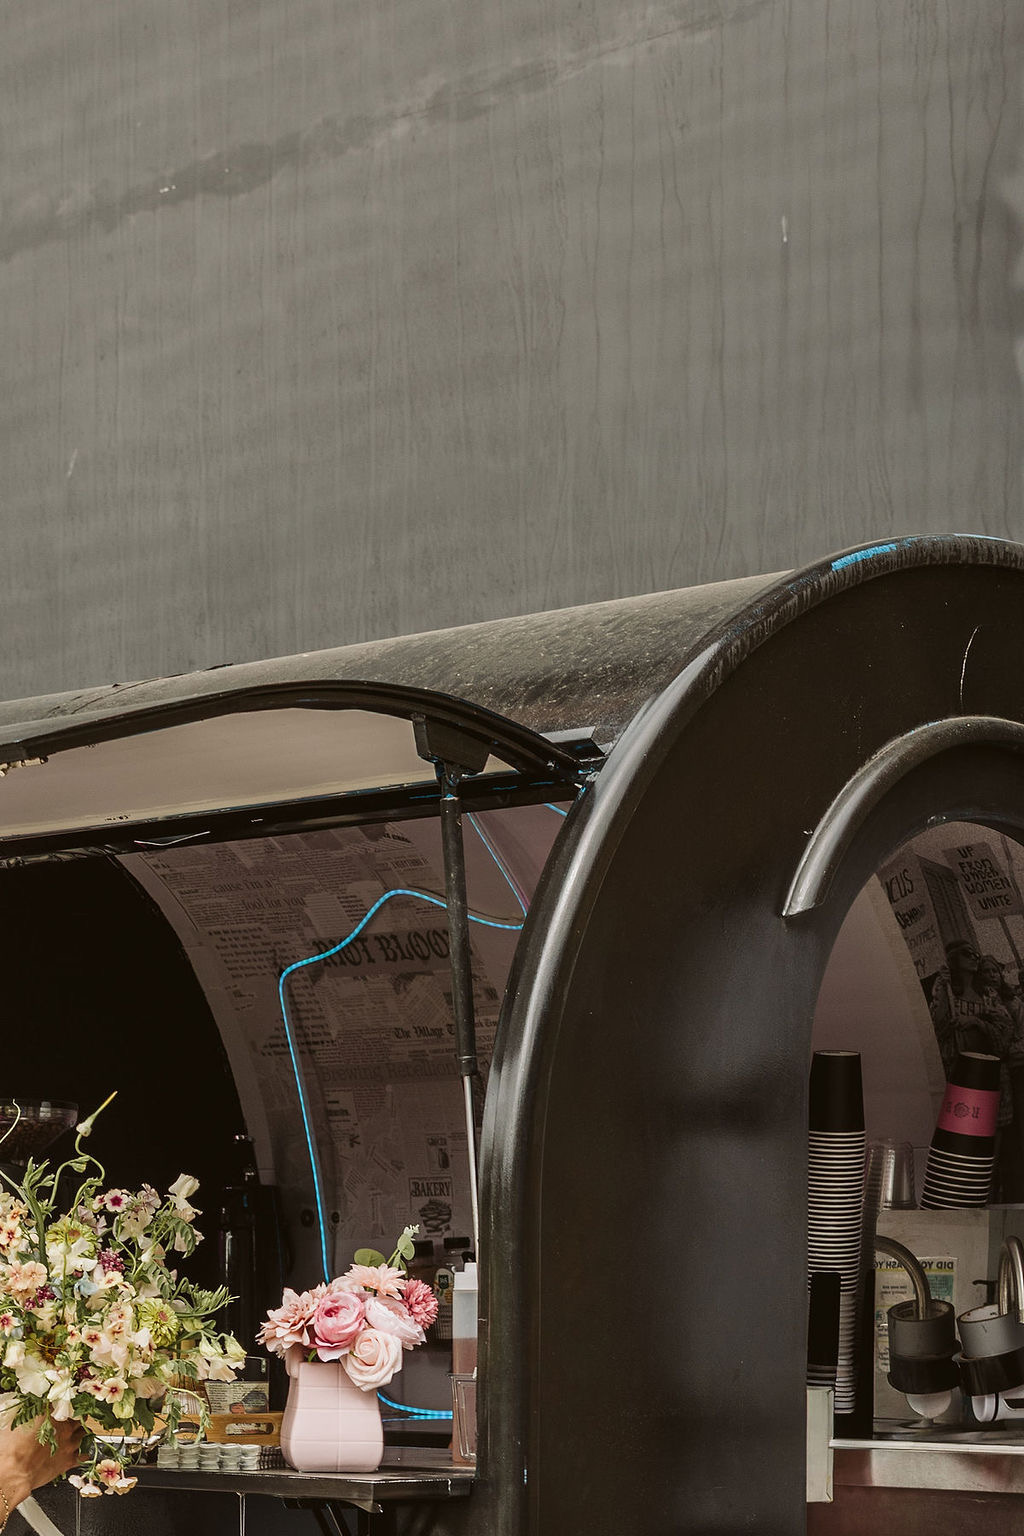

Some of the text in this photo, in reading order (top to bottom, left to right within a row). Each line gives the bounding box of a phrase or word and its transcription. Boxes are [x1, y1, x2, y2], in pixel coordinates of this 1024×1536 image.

[964, 876, 1012, 896] WOMEN
[978, 894, 1012, 911] UNITE
[375, 928, 453, 963] BLOO
[412, 1025, 445, 1041] Village
[411, 1181, 451, 1198] BAKERY
